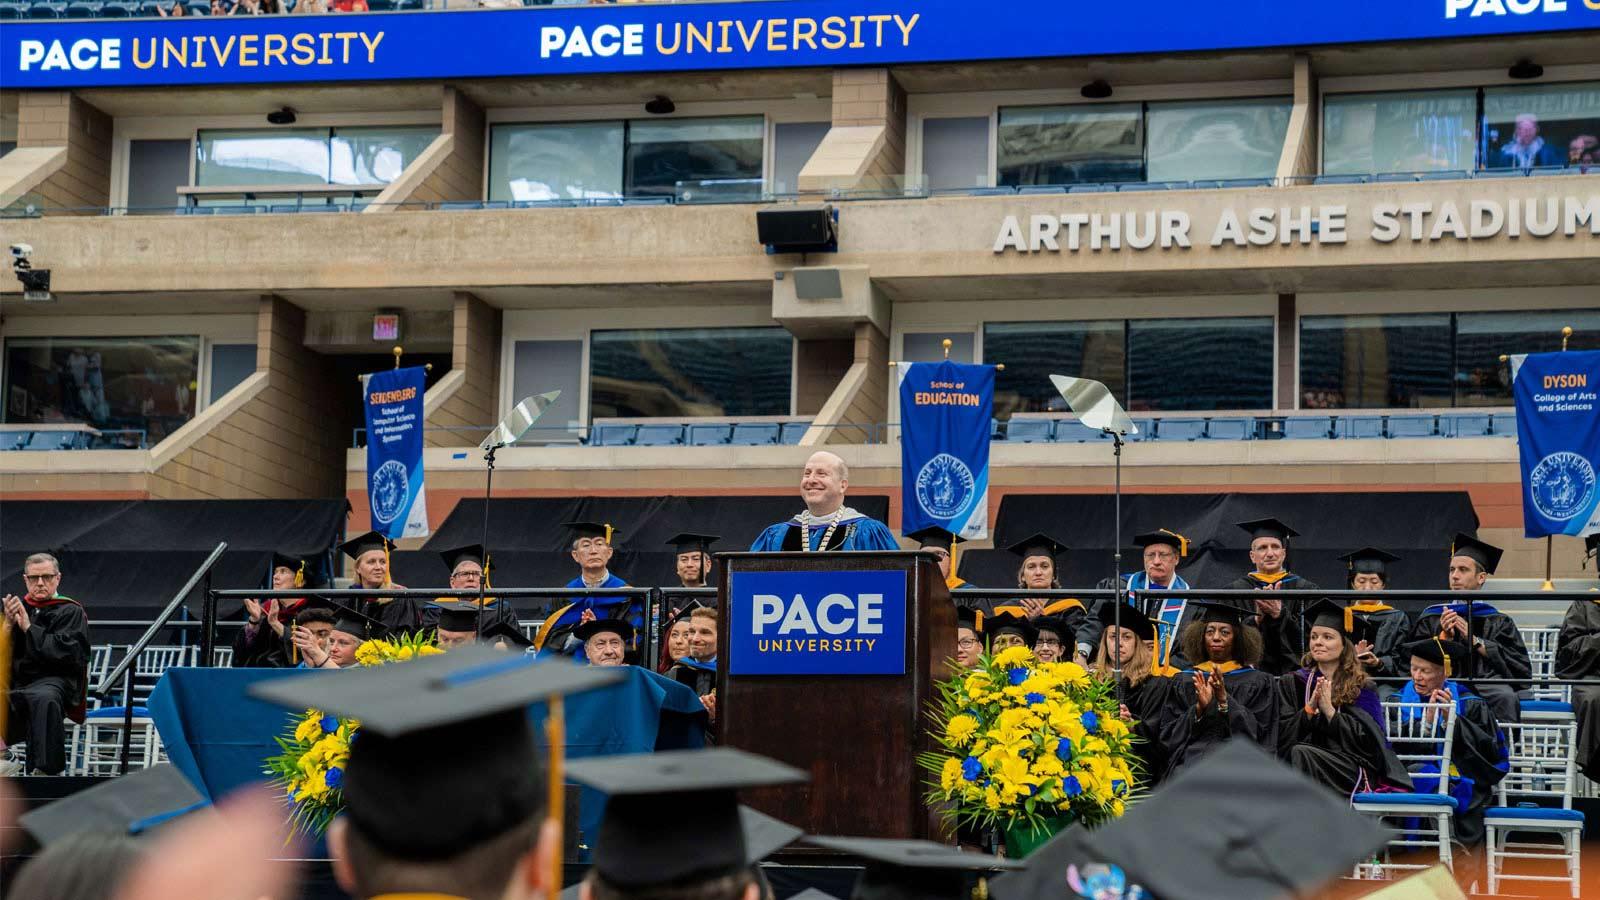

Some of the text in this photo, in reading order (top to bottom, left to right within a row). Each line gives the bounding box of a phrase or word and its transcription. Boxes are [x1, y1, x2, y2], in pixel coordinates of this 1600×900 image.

[540, 14, 920, 58] PACE UNIVERSITY
[19, 31, 385, 71] PACE UNIVERSITY
[993, 196, 1600, 253] ARTHUR ASHE STADIUM
[930, 381, 954, 389] School
[1543, 374, 1587, 389] DYSON
[370, 387, 417, 405] SEIDENBERG
[915, 392, 980, 407] EDUCATION
[1534, 393, 1566, 402] College
[1579, 392, 1597, 400] Arts
[1538, 403, 1593, 412] and Sciences
[752, 593, 883, 635] PACE
[758, 639, 876, 652] UNIVERSITY
